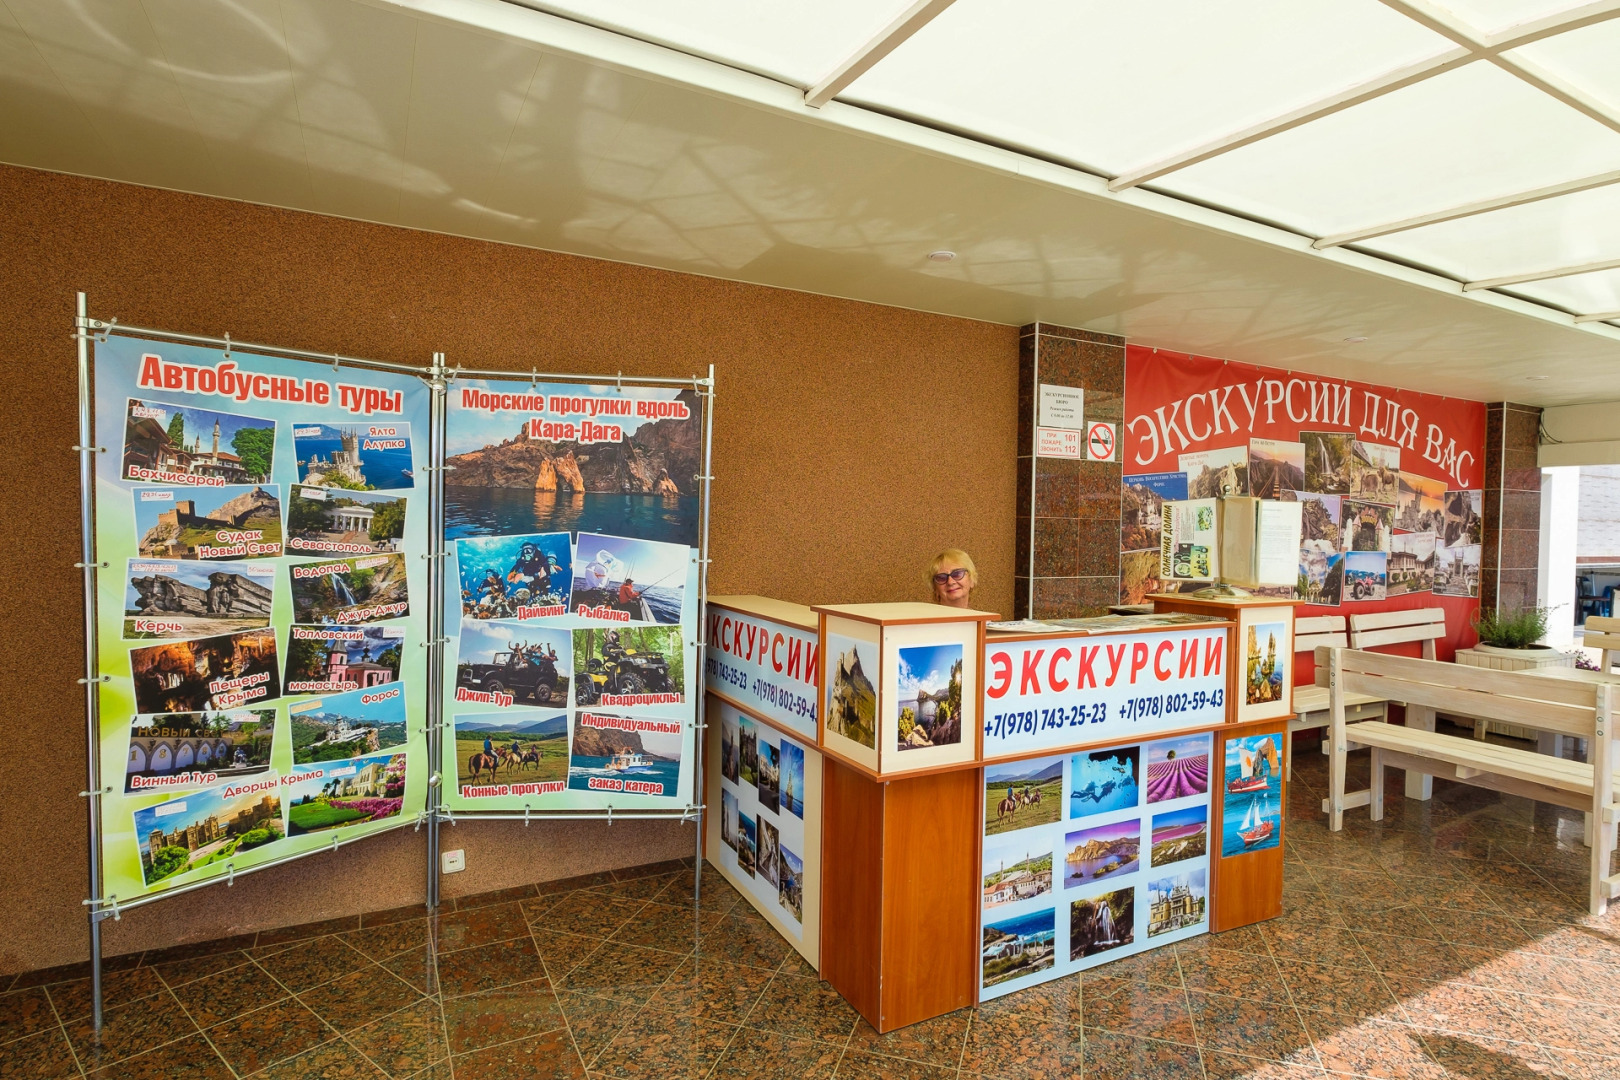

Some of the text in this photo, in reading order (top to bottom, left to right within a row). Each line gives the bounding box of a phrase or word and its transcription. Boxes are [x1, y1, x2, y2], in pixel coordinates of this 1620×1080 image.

[140, 356, 402, 414] Автобусные туры
[462, 389, 689, 419] Морские прогулки вдоль
[369, 426, 396, 437] Ялта
[531, 419, 621, 442] Кара-Дага
[1064, 433, 1076, 442] 101
[1127, 376, 1475, 488] ЭКСКУРСИИ ДЛЯ ВАС
[362, 438, 406, 451] Алупка
[1064, 445, 1076, 454] 112
[128, 465, 225, 487] Бахчисарай
[216, 530, 262, 544] Судак
[1162, 504, 1173, 577] СОЛНЕЧНАЯ ДОЛИНА
[199, 541, 281, 558] Новый Свет
[290, 538, 372, 555] Севастополь
[294, 562, 350, 579] Водопад
[337, 601, 408, 624] Джур-Джур
[517, 603, 566, 621] Дайвинг
[578, 604, 630, 622] Рыбалка
[135, 619, 183, 632] Керчь
[293, 627, 364, 641] Топловский
[986, 636, 1224, 699] ЭКСКУРСИИ
[209, 671, 270, 694] Пещеры
[289, 680, 359, 691] монастырь
[719, 662, 747, 690] 743-25-23
[752, 678, 778, 708] +7(978)
[218, 686, 267, 705] Крыма
[361, 688, 399, 704] Форос
[456, 688, 513, 707] Джип-Тур
[601, 693, 680, 706] Квадроциклы
[984, 688, 1224, 740] +7(978) 743-25-23 +7(978) 802-59-43
[581, 713, 681, 734] Индивидуальный
[132, 772, 217, 789] Винный Тур
[223, 778, 278, 799] Дворцы
[280, 769, 324, 787] Крыма
[588, 777, 664, 795] заказ катера
[462, 781, 565, 799] Конные прогулки
